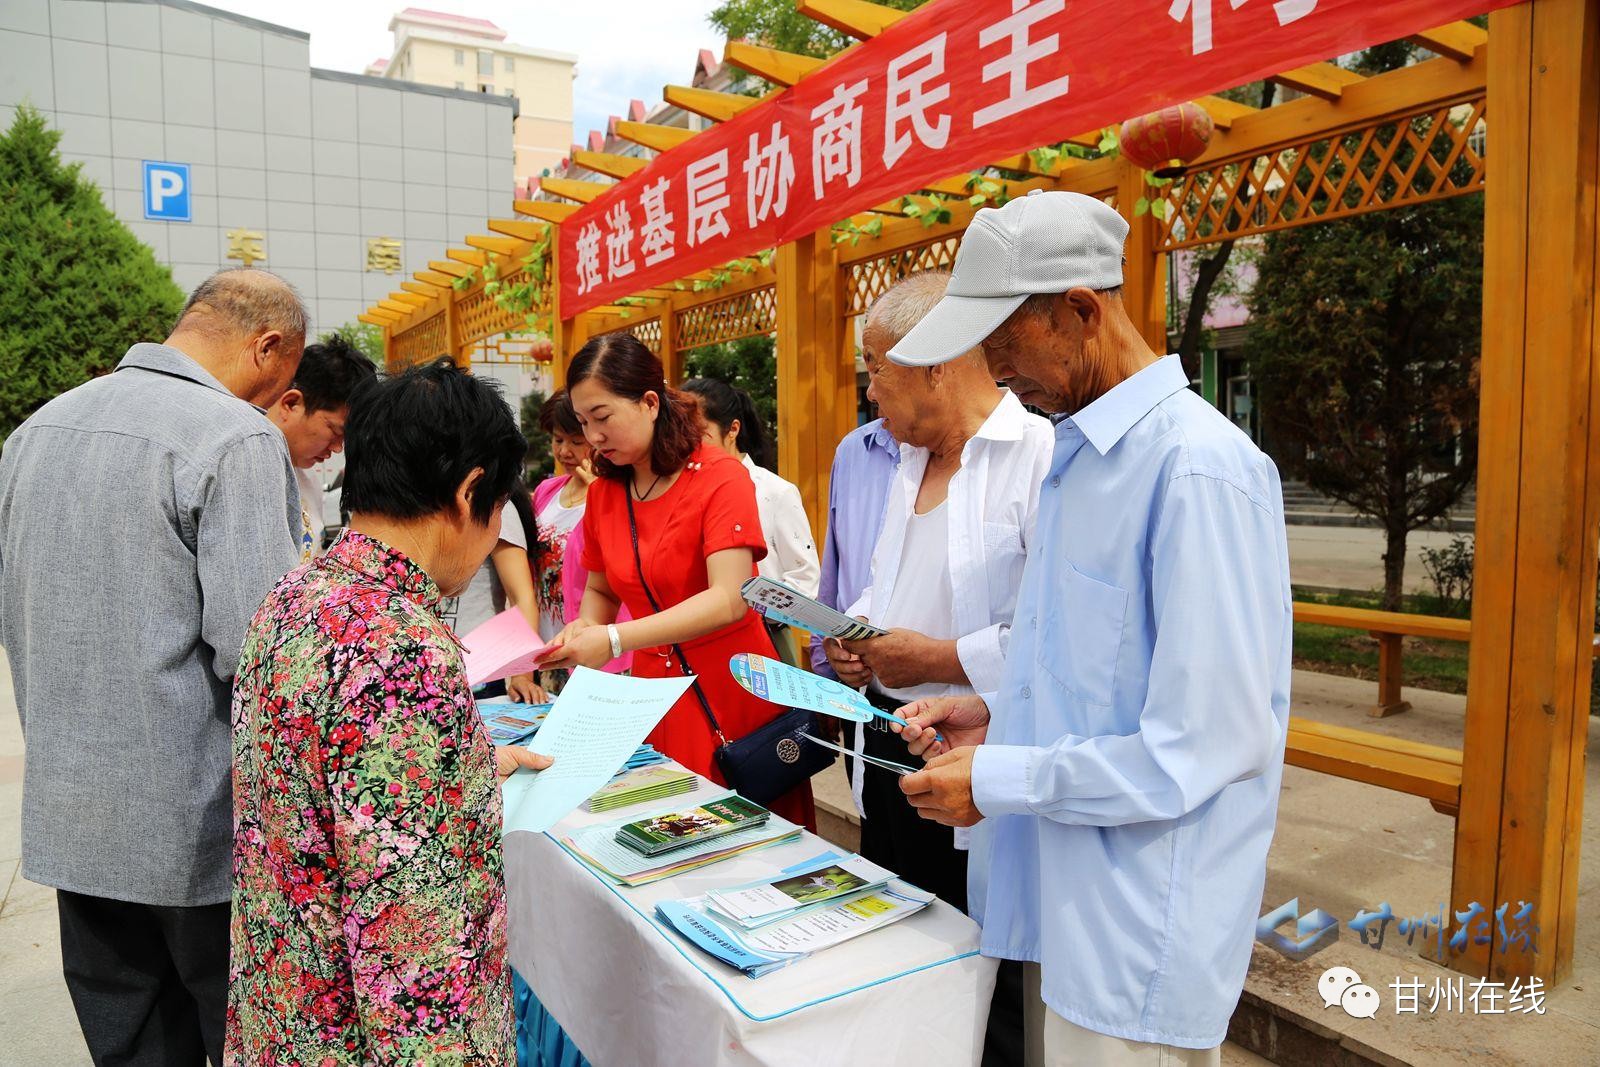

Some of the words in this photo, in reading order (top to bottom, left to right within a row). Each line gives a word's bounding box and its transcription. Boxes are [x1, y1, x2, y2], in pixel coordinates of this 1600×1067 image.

[150, 170, 184, 212] P
[575, 0, 1071, 297] 推进基层协商民主
